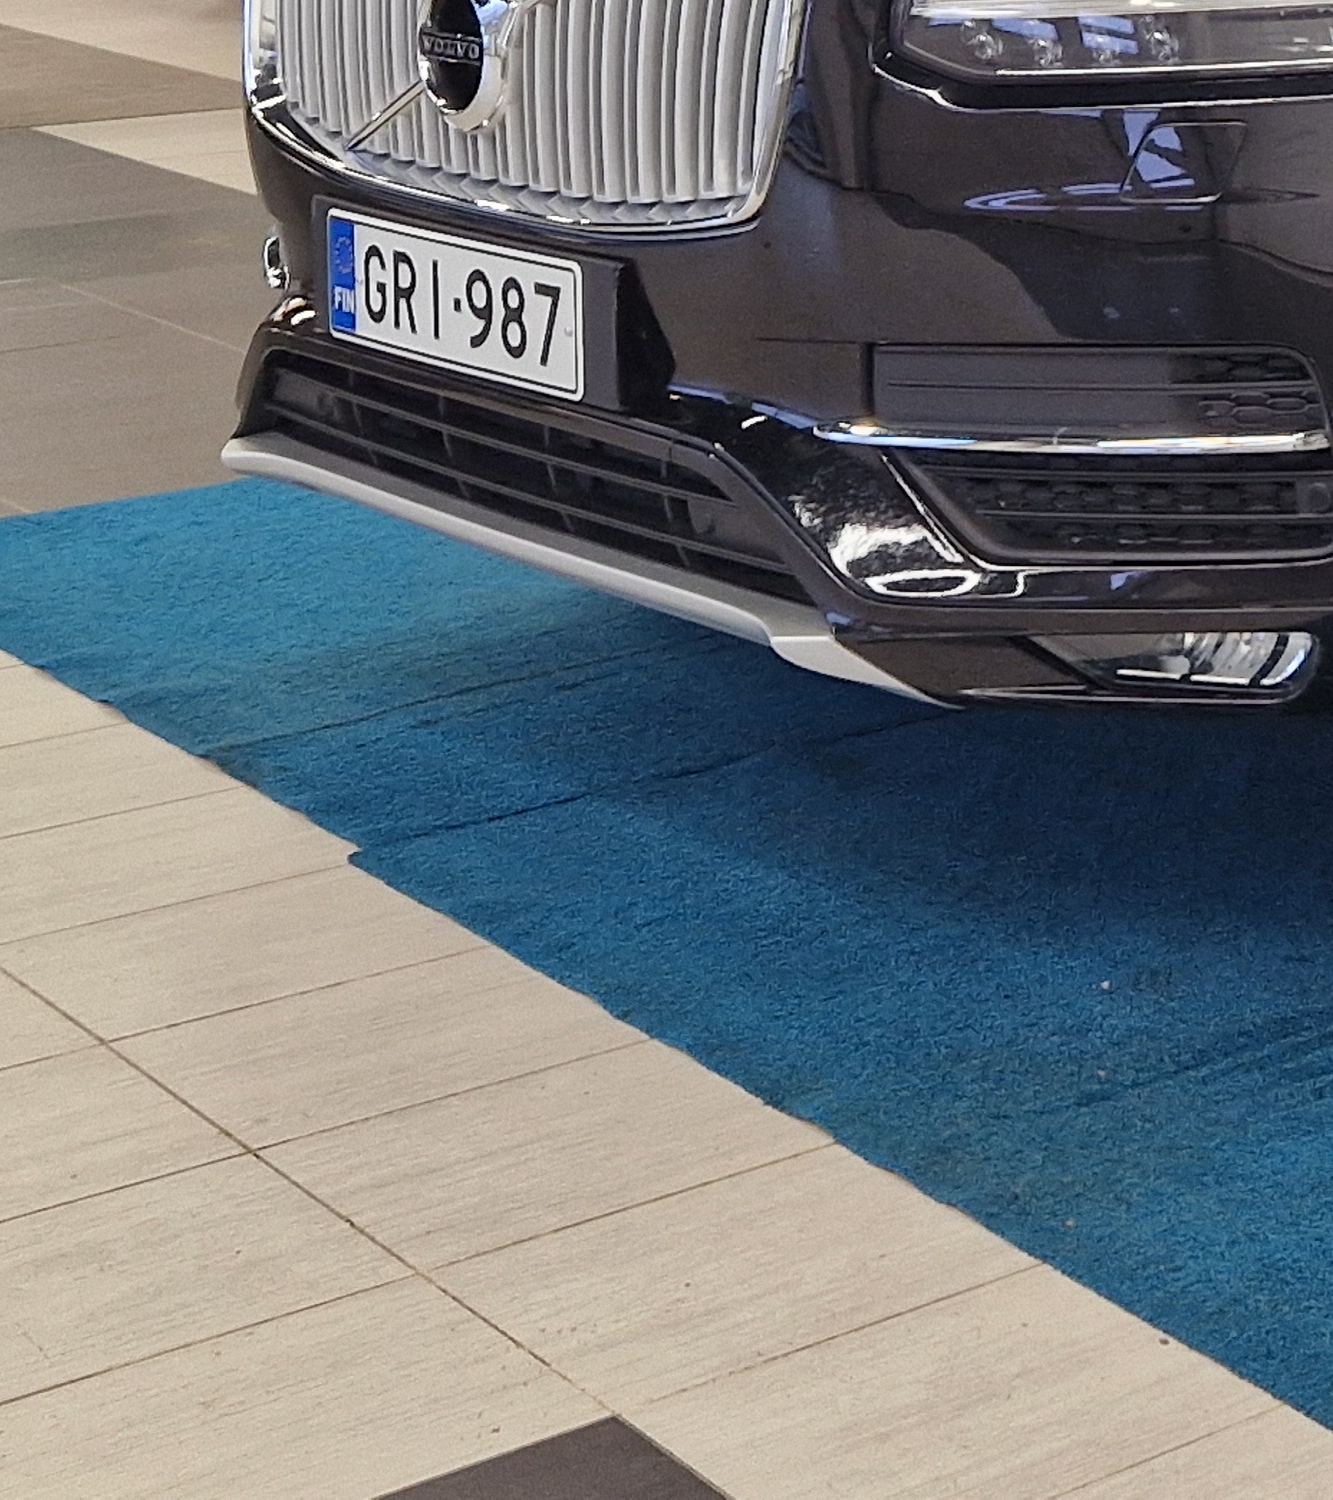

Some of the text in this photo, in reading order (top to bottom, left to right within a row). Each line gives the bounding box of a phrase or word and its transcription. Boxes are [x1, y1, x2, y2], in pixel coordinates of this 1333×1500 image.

[423, 36, 480, 59] VOLVO
[334, 285, 354, 314] FIN
[364, 244, 561, 367] GRI-987
